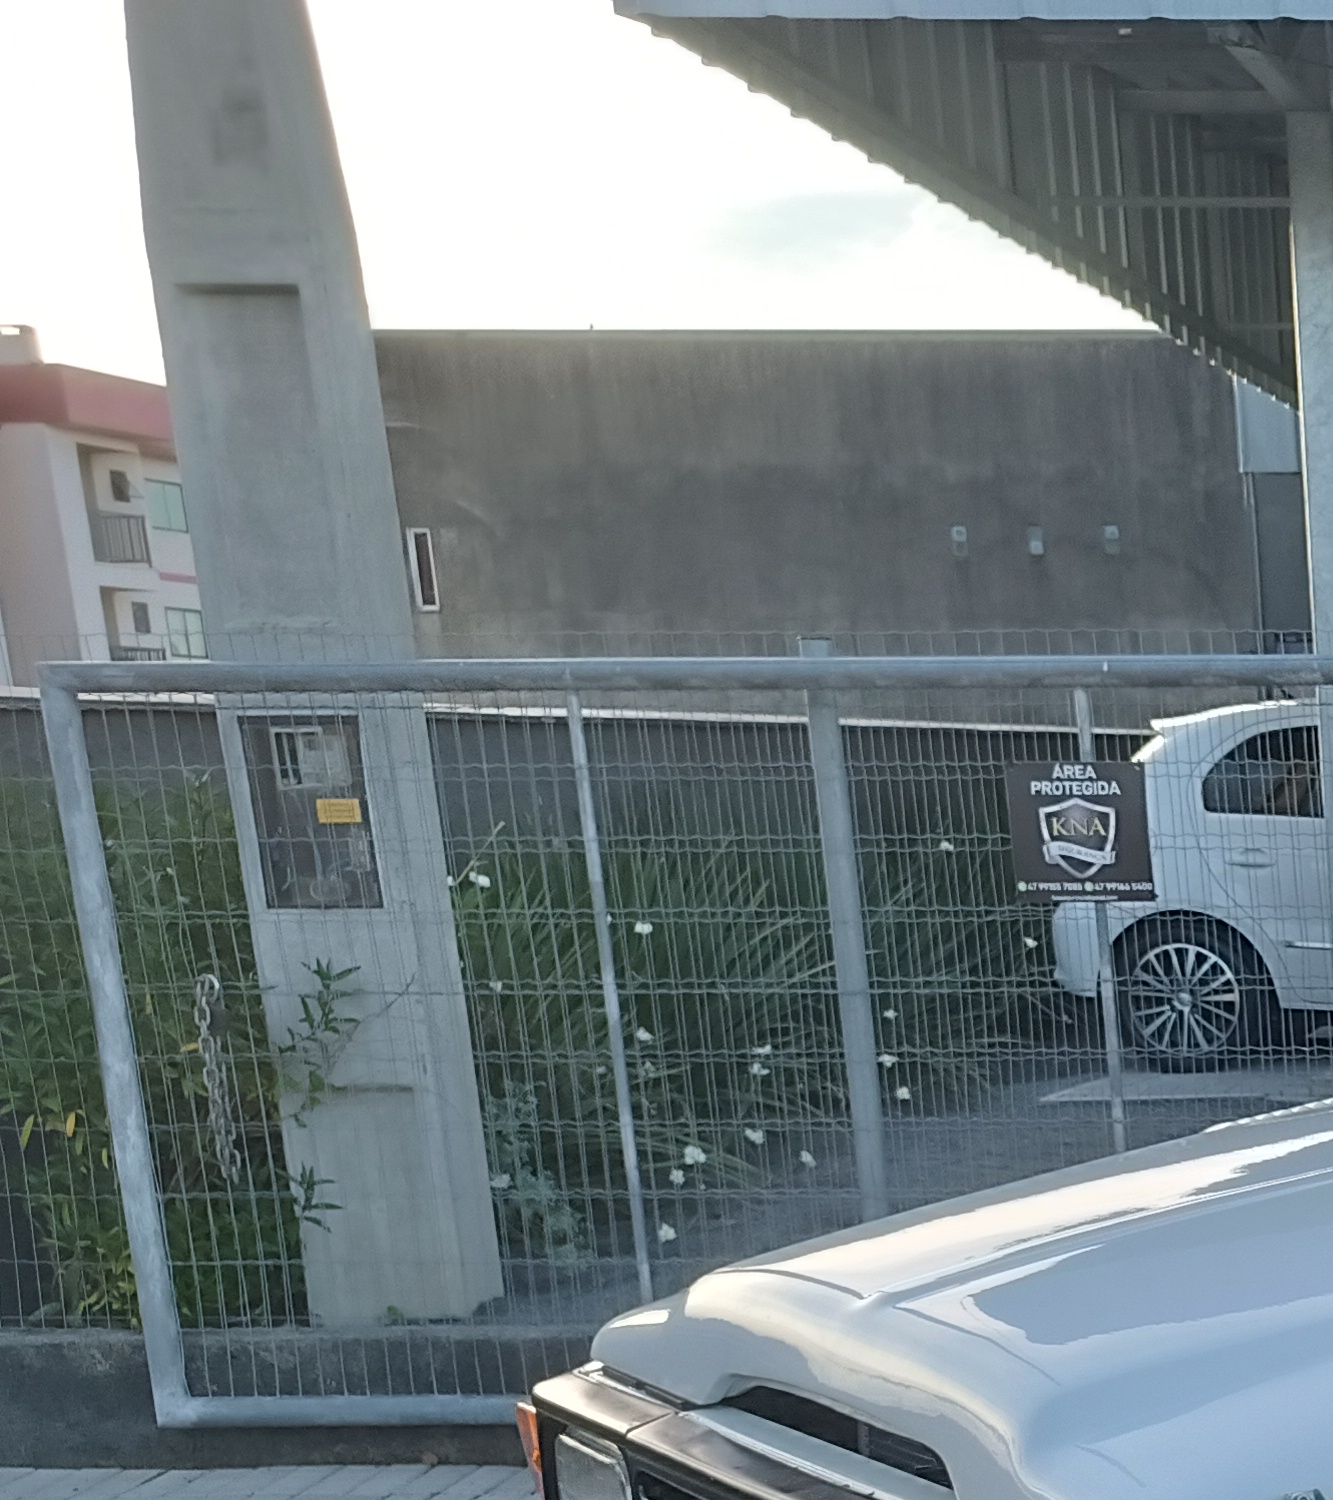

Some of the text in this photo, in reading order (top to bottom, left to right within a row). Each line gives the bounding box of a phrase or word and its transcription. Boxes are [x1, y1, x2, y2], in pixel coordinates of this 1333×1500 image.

[1052, 762, 1097, 779] ÁREA
[1030, 780, 1122, 796] PROTEGIDA
[1050, 816, 1107, 836] KNA
